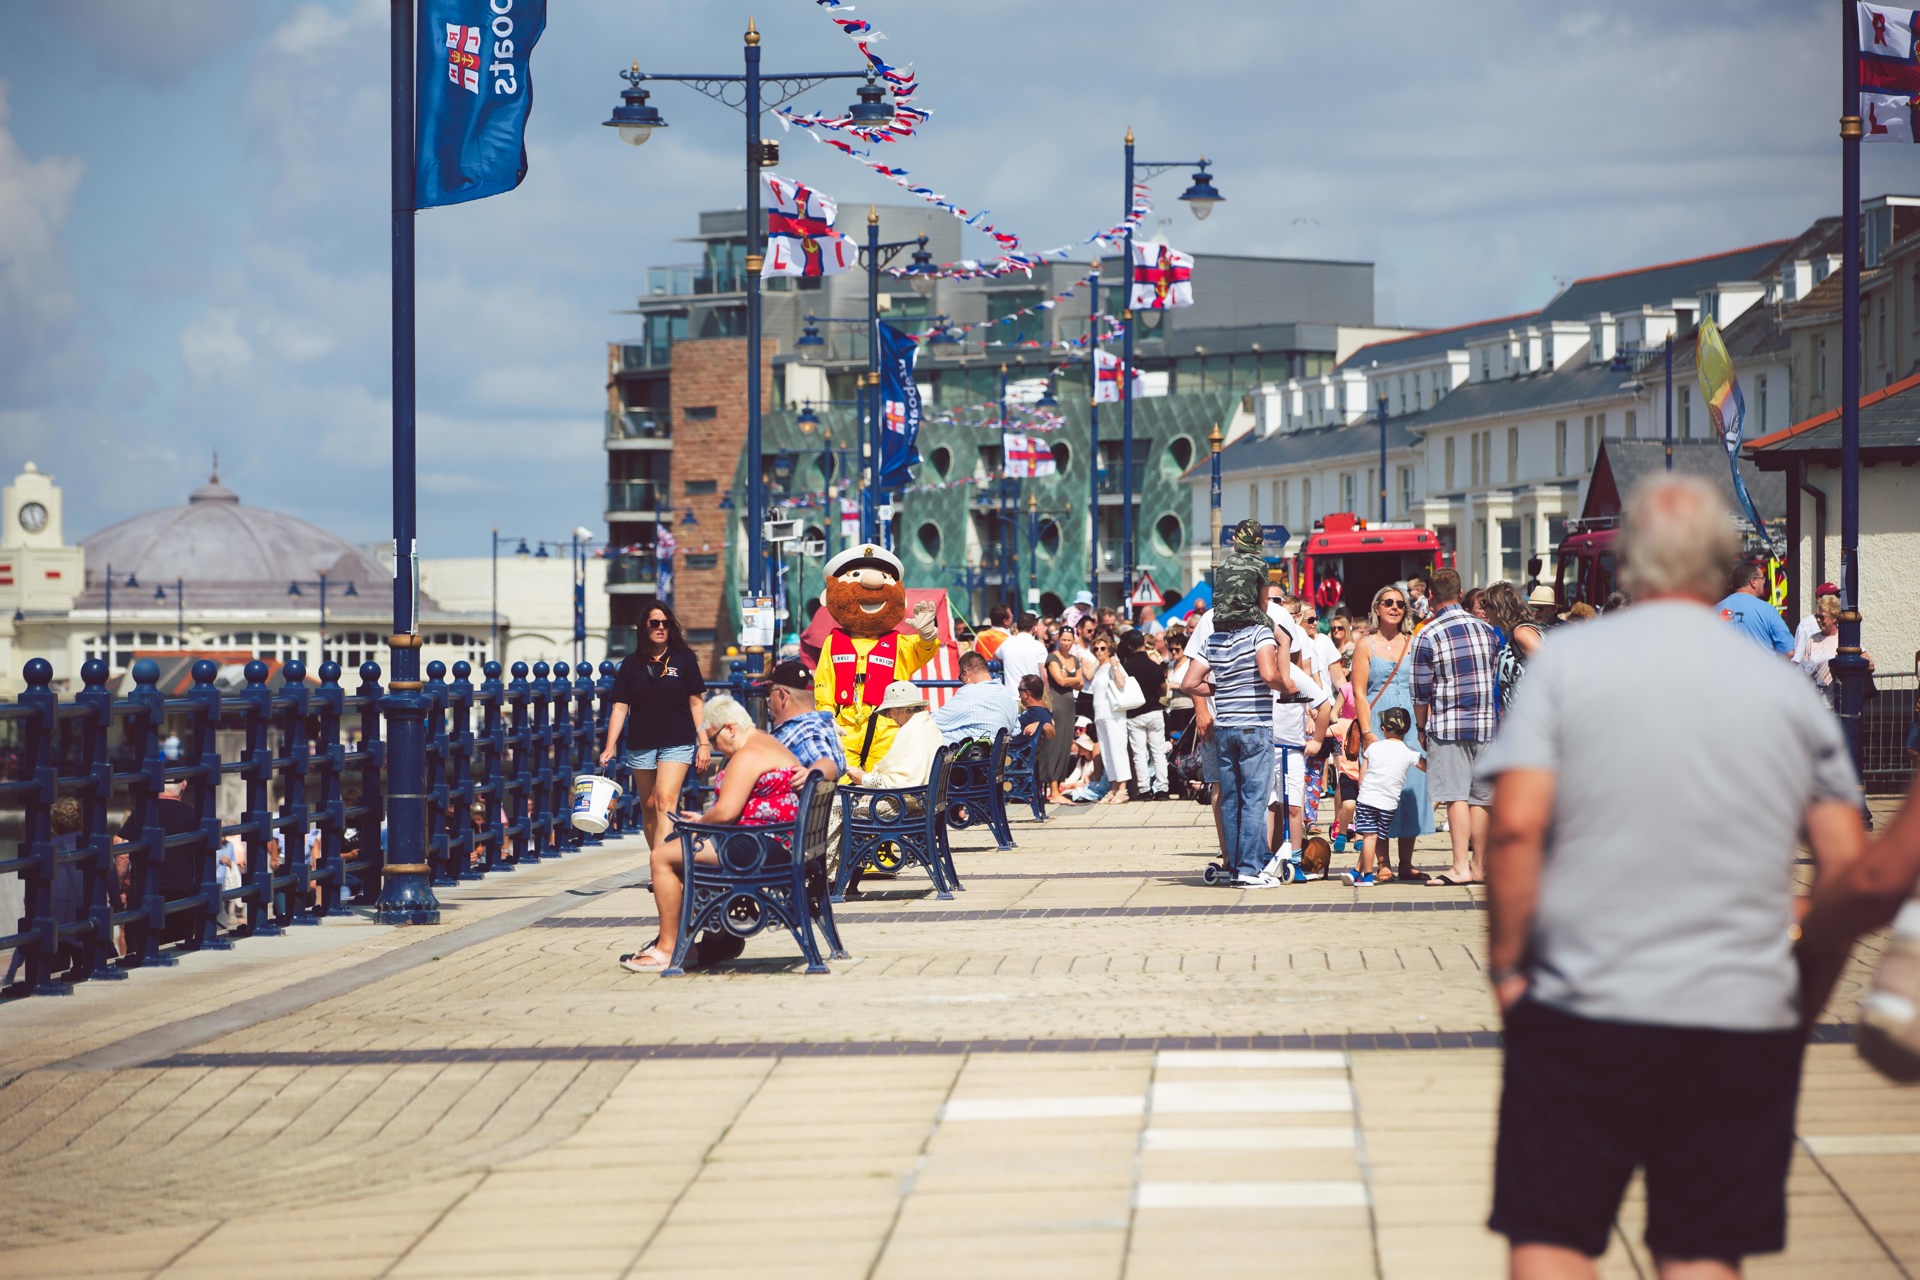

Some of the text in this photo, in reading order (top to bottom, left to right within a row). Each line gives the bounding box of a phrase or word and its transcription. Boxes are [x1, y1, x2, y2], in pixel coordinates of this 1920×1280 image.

[1872, 12, 1888, 47] R
[1868, 102, 1888, 134] L
[774, 243, 787, 270] L
